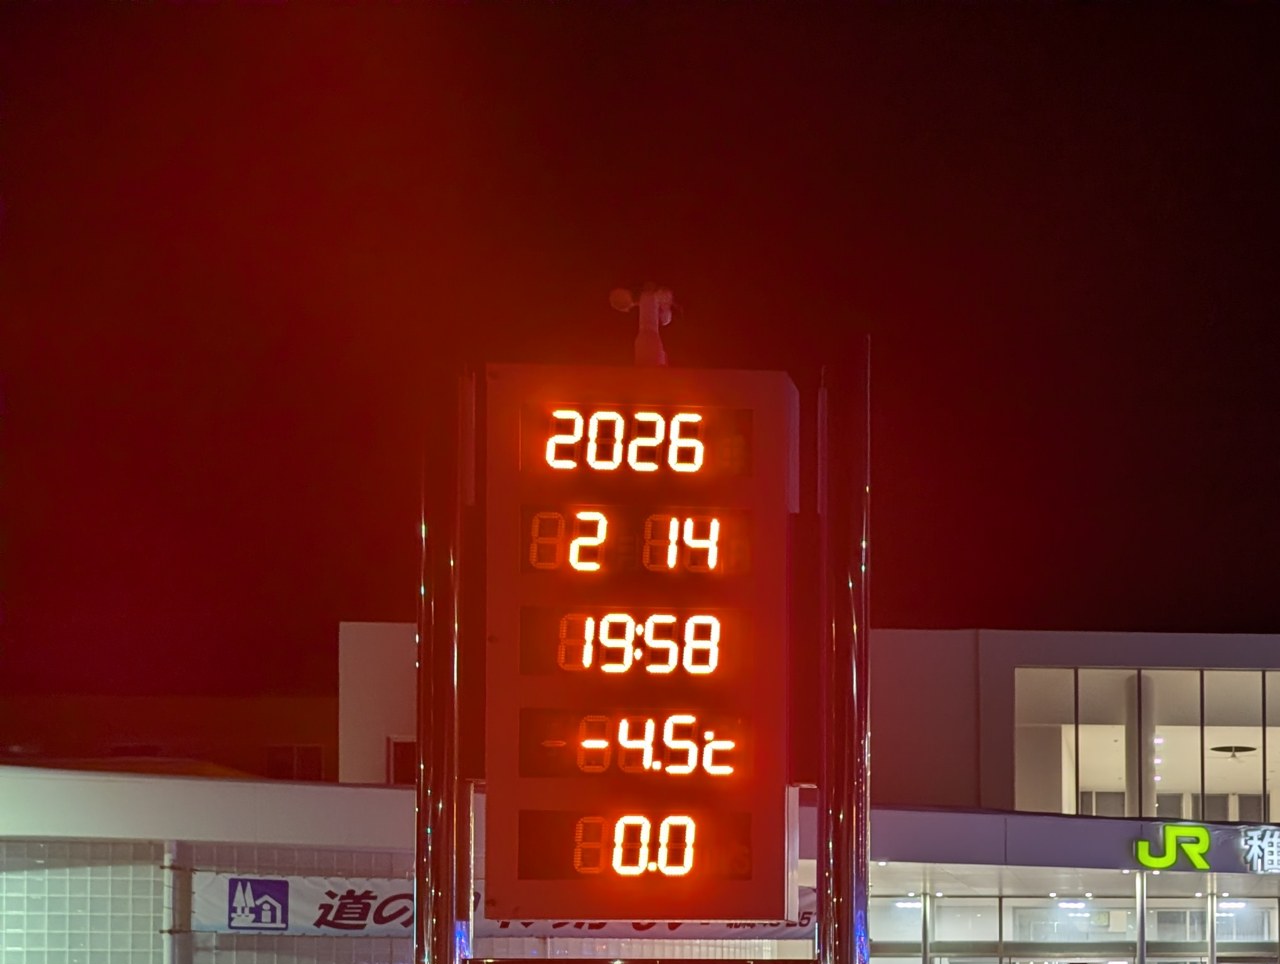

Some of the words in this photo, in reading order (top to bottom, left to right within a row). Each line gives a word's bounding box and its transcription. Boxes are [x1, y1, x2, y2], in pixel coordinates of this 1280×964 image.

[545, 409, 704, 473] 2026
[568, 511, 608, 572] 2
[667, 516, 721, 570] 14
[582, 612, 720, 675] 19:58
[611, 814, 697, 877] 0.0
[1136, 824, 1211, 871] JR
